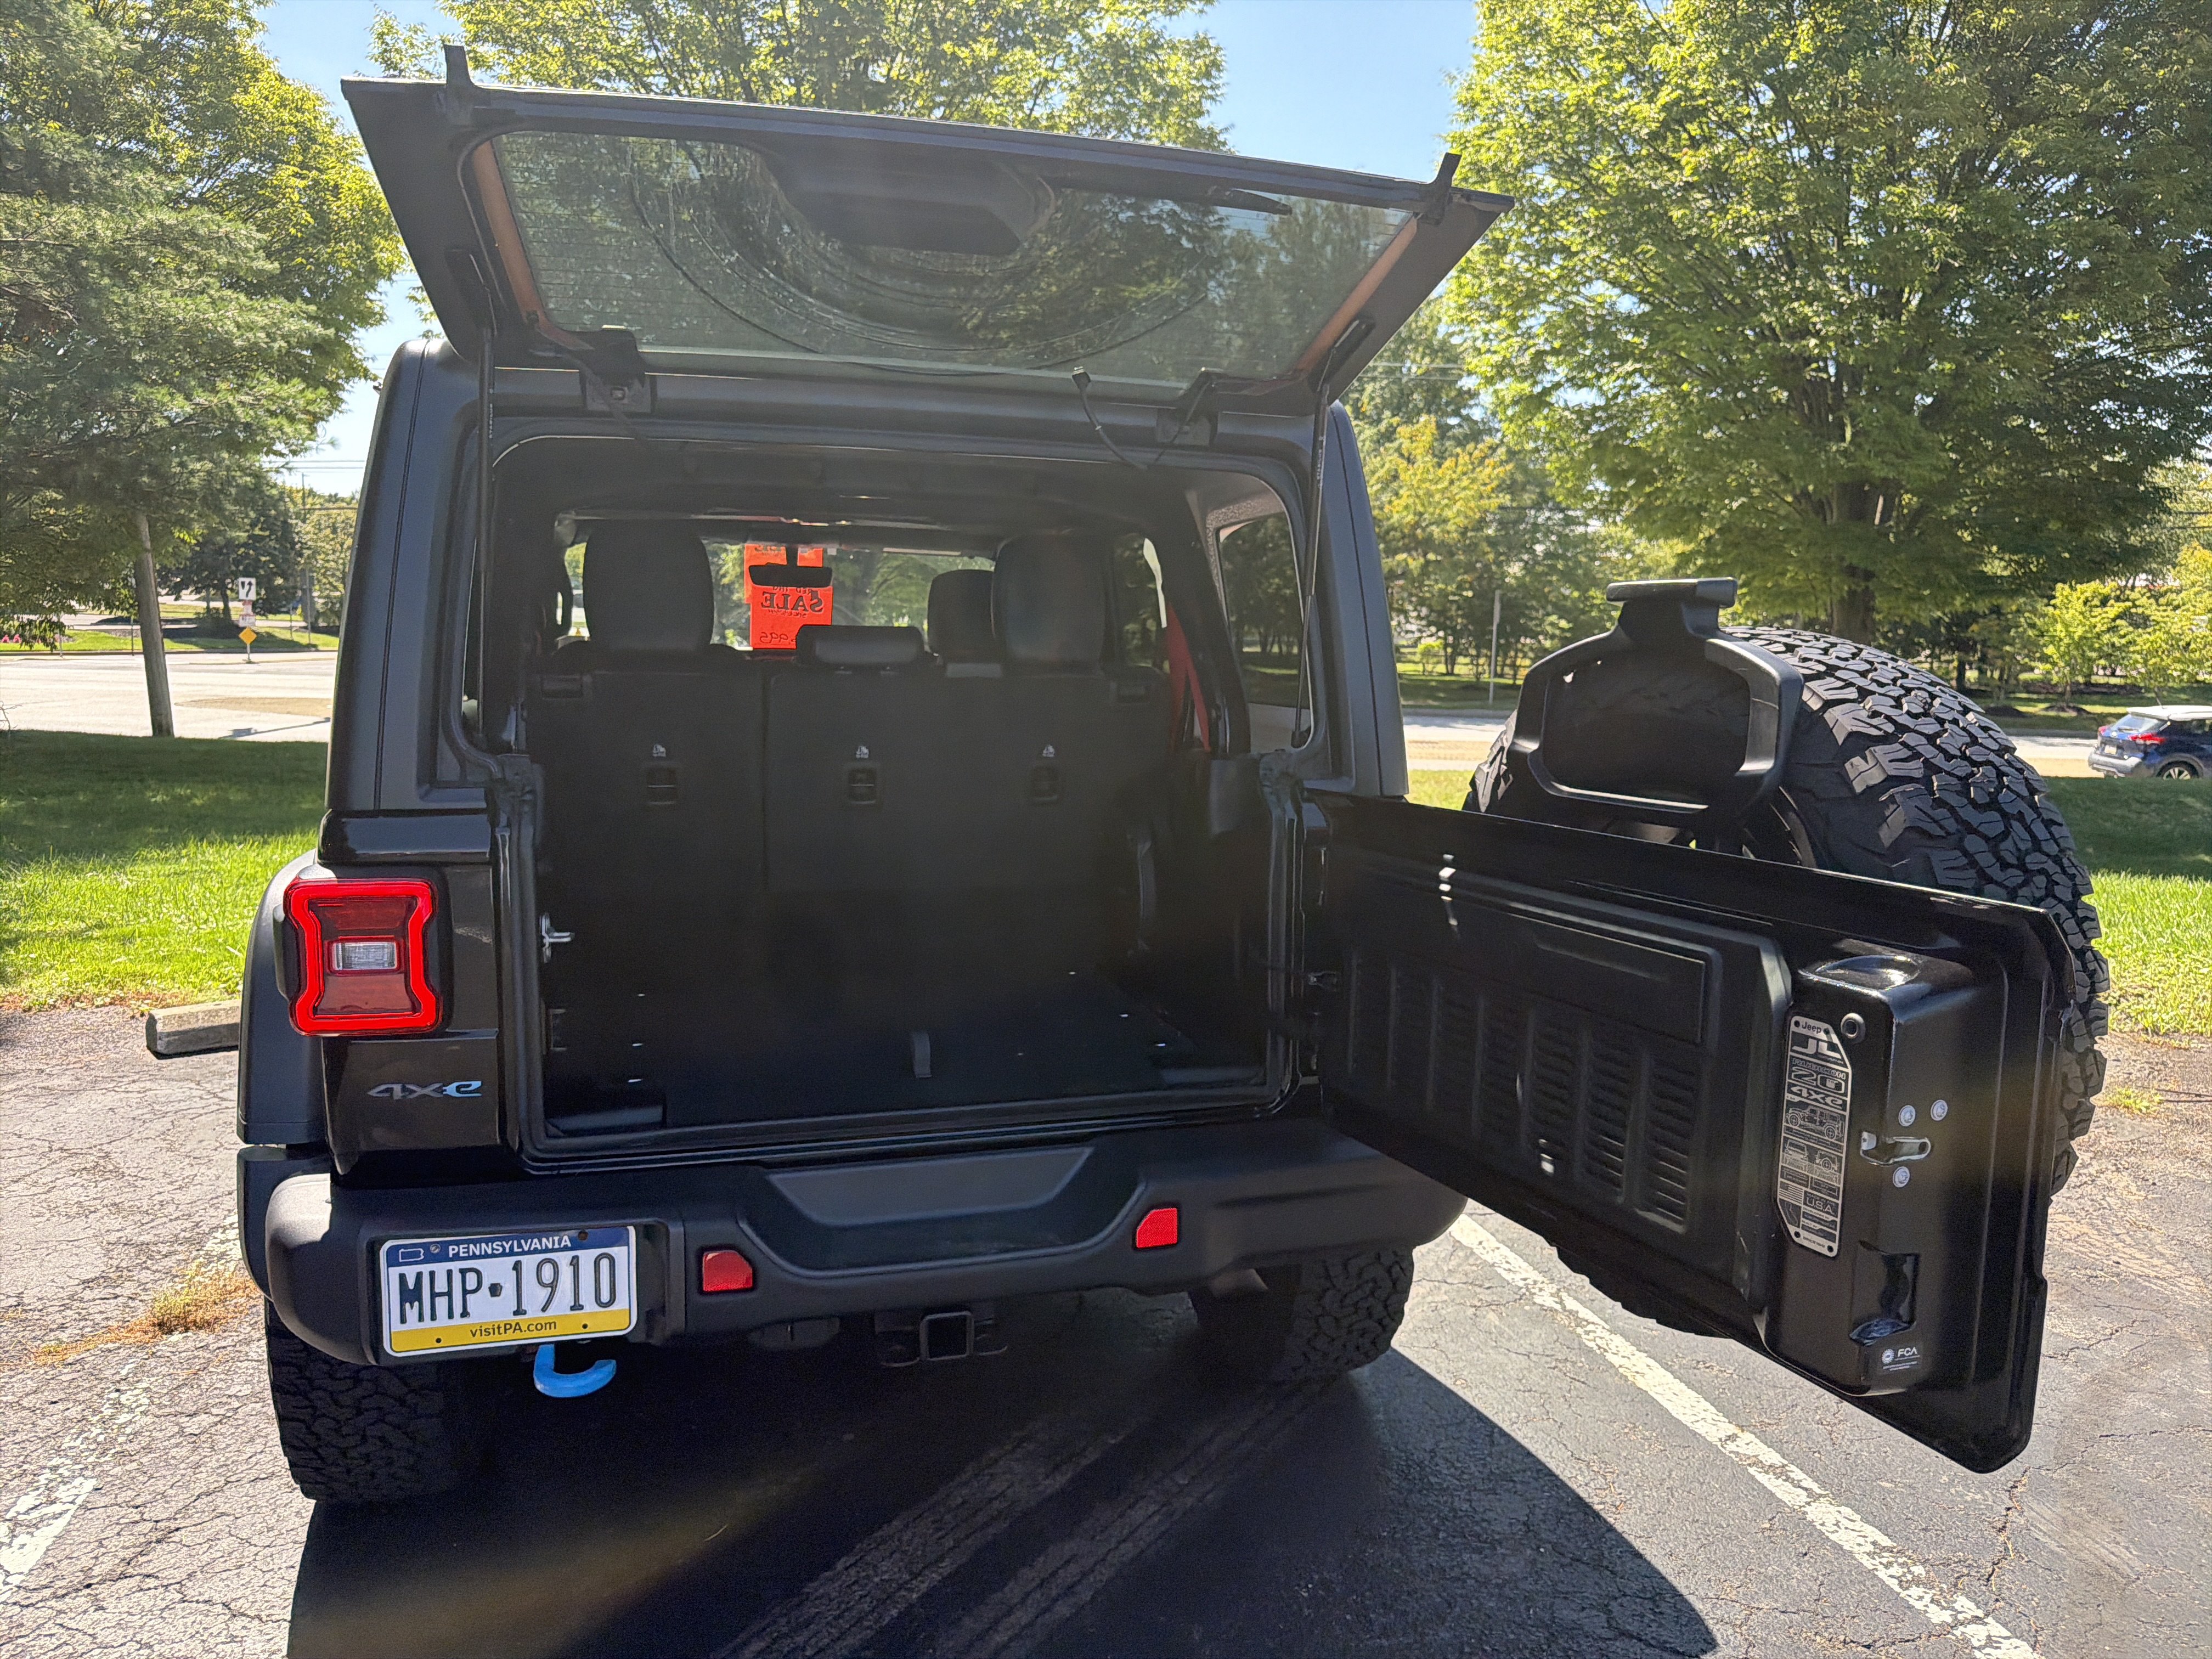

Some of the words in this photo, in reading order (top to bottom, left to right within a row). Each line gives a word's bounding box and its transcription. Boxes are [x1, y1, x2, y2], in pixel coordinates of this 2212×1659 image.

[1802, 1022, 1822, 1035] Jeep
[449, 1234, 571, 1257] PENNSYLVANIA
[399, 1268, 483, 1324] MHP
[512, 1252, 616, 1316] 1910
[470, 1320, 557, 1338] visitPA.com
[1898, 1346, 1917, 1357] FCA
